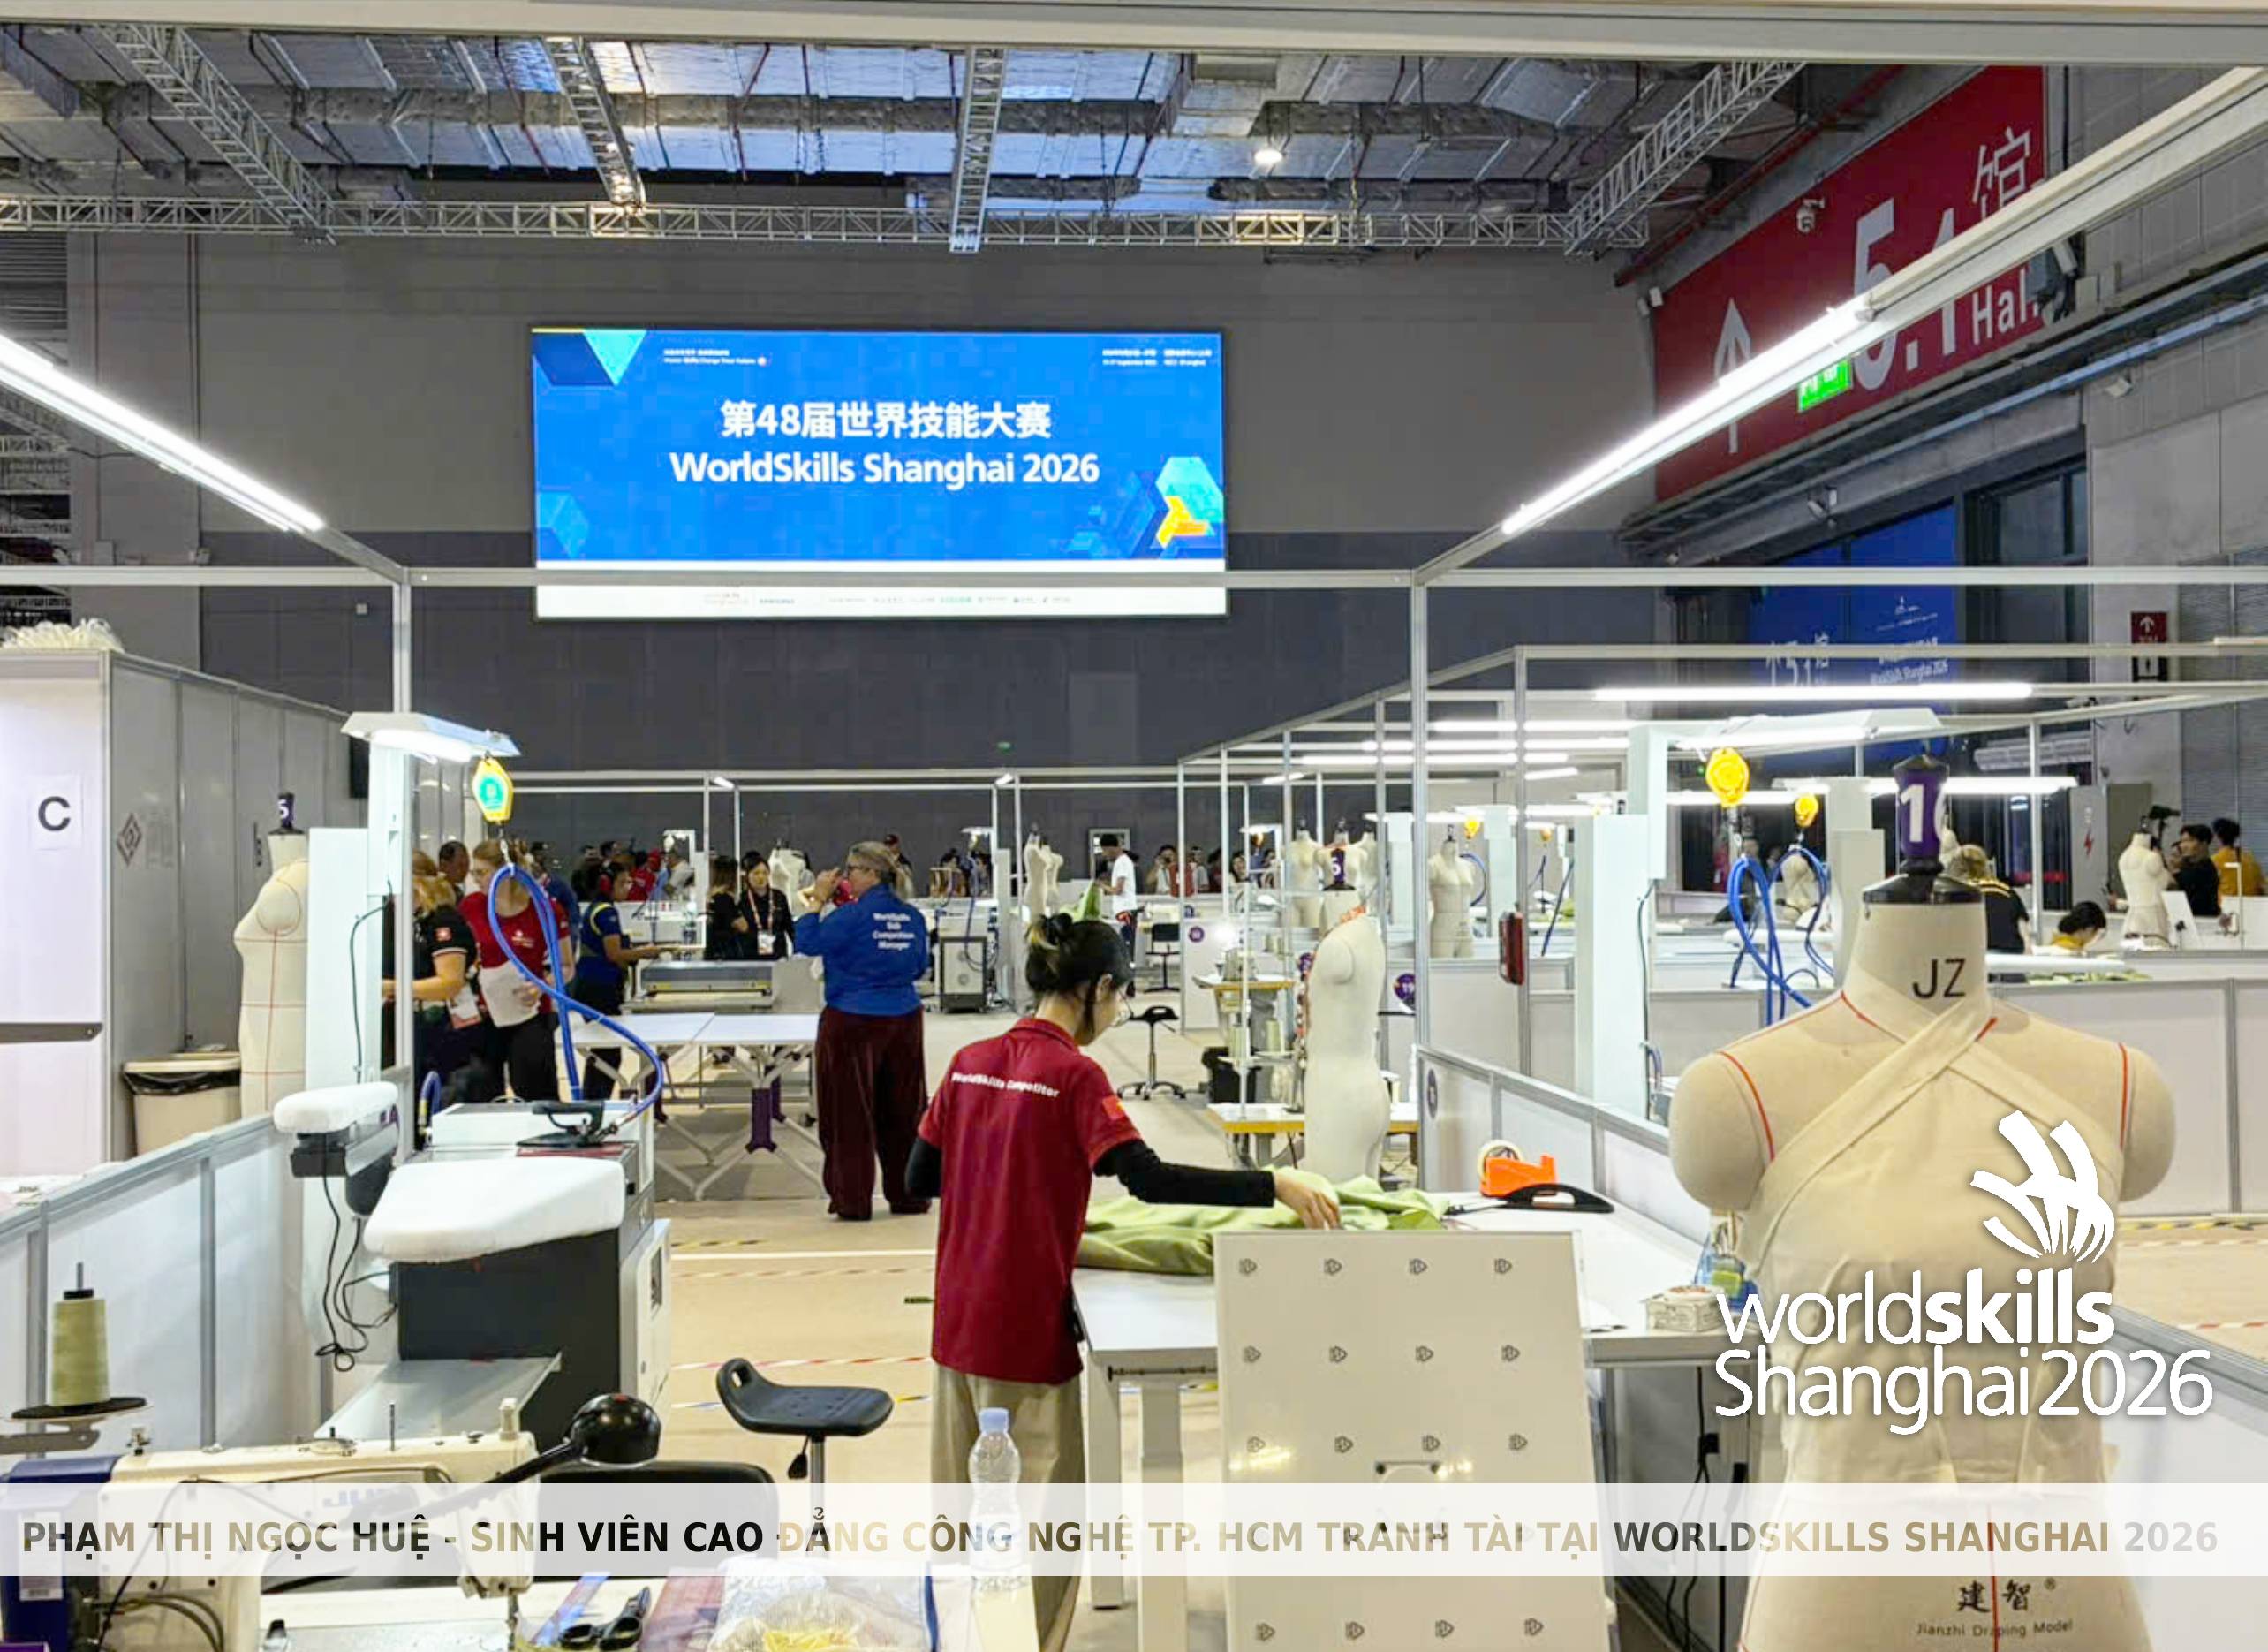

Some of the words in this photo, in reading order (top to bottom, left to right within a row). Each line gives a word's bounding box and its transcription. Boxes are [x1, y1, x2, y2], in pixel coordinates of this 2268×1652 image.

[720, 399, 1052, 440] 第48届世界技能大赛
[669, 451, 856, 484] WorldSkills
[863, 451, 1015, 491] Shanghai
[1023, 452, 1100, 484] 2026
[37, 796, 71, 832] C
[1912, 957, 1967, 1000] JZ
[1957, 1579, 2031, 1613] 建智
[1916, 1622, 1965, 1636] Jianzhi
[2033, 1619, 2073, 1634] Model
